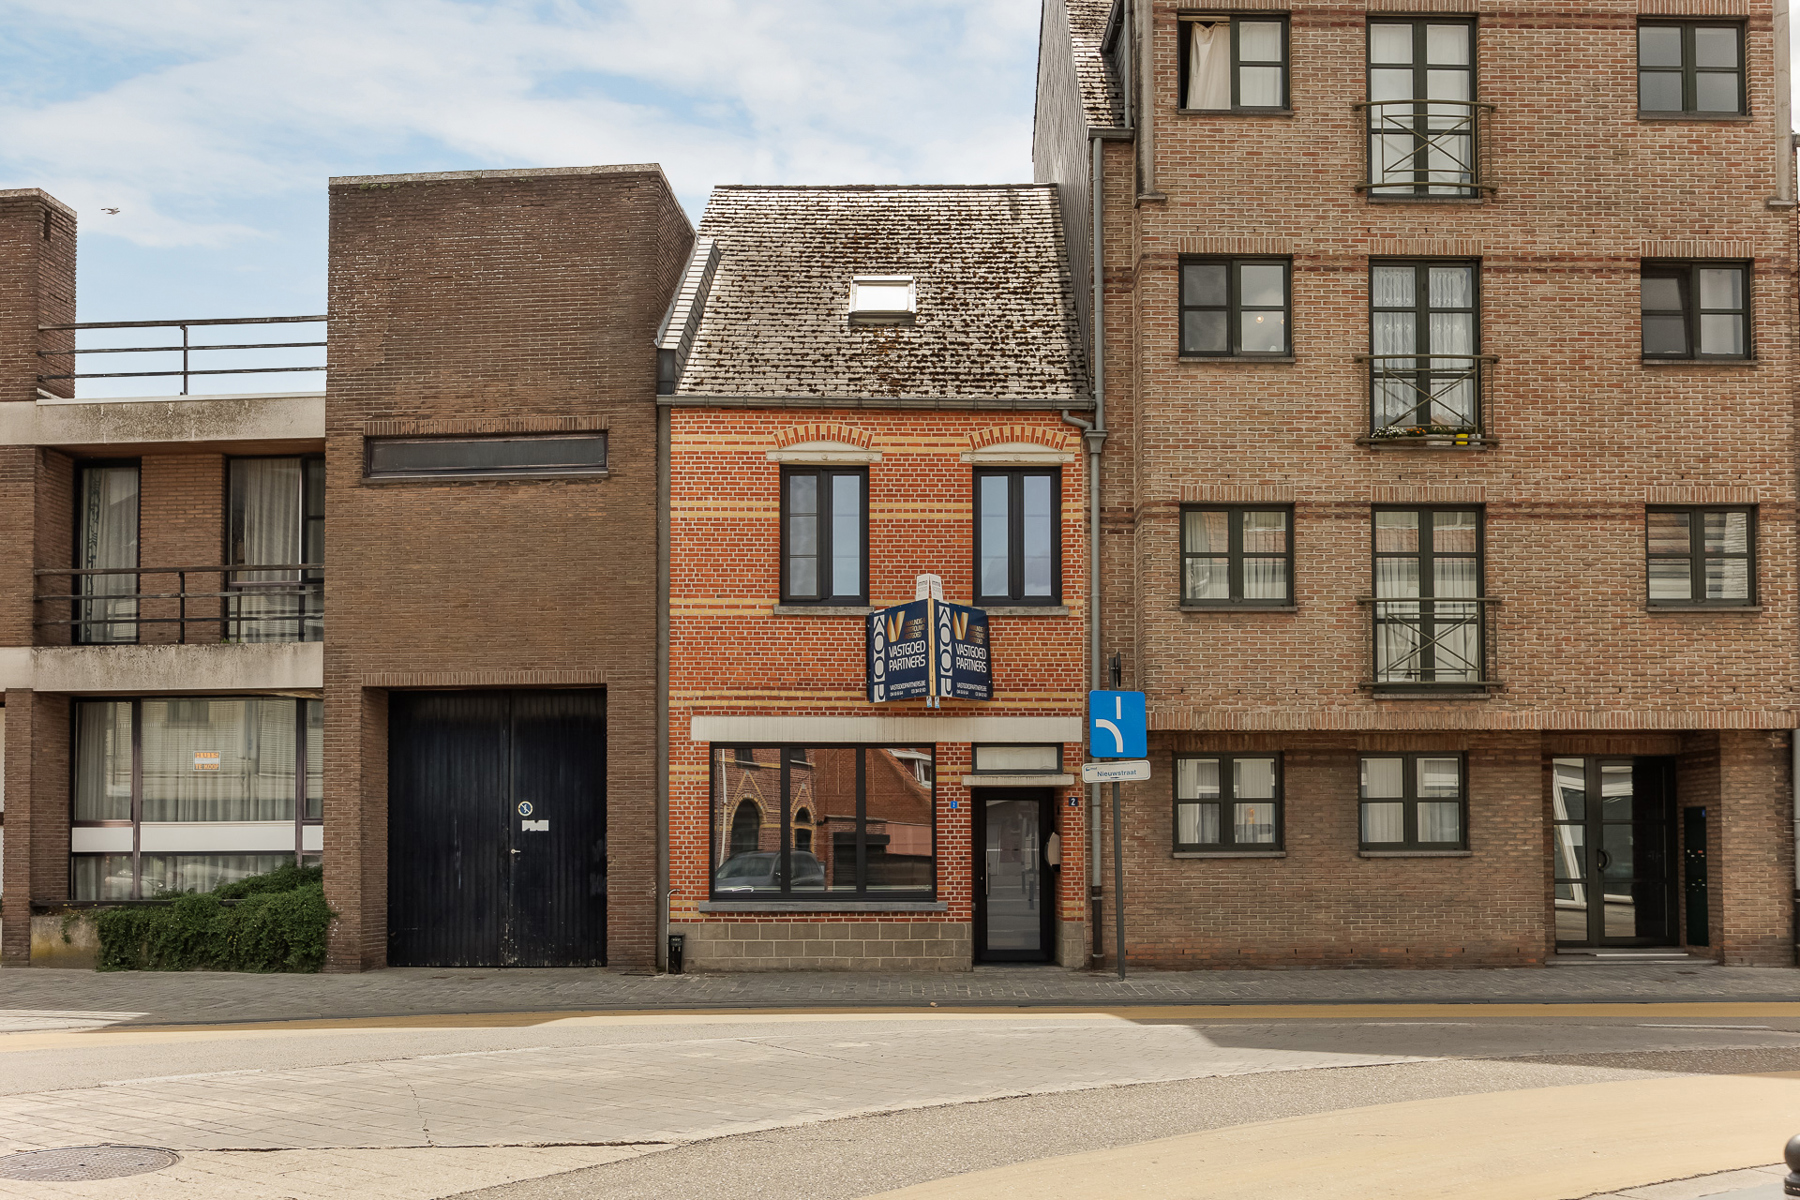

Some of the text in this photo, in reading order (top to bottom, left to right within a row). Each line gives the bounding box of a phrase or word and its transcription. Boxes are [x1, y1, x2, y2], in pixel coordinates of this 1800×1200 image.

[888, 640, 926, 658] VASTGOED
[955, 642, 987, 660] VASTGOED
[888, 654, 926, 672] PARTNERS
[956, 656, 987, 673] PARTNERS
[1097, 769, 1137, 777] Nieuwstraat
[1070, 797, 1077, 806] 2
